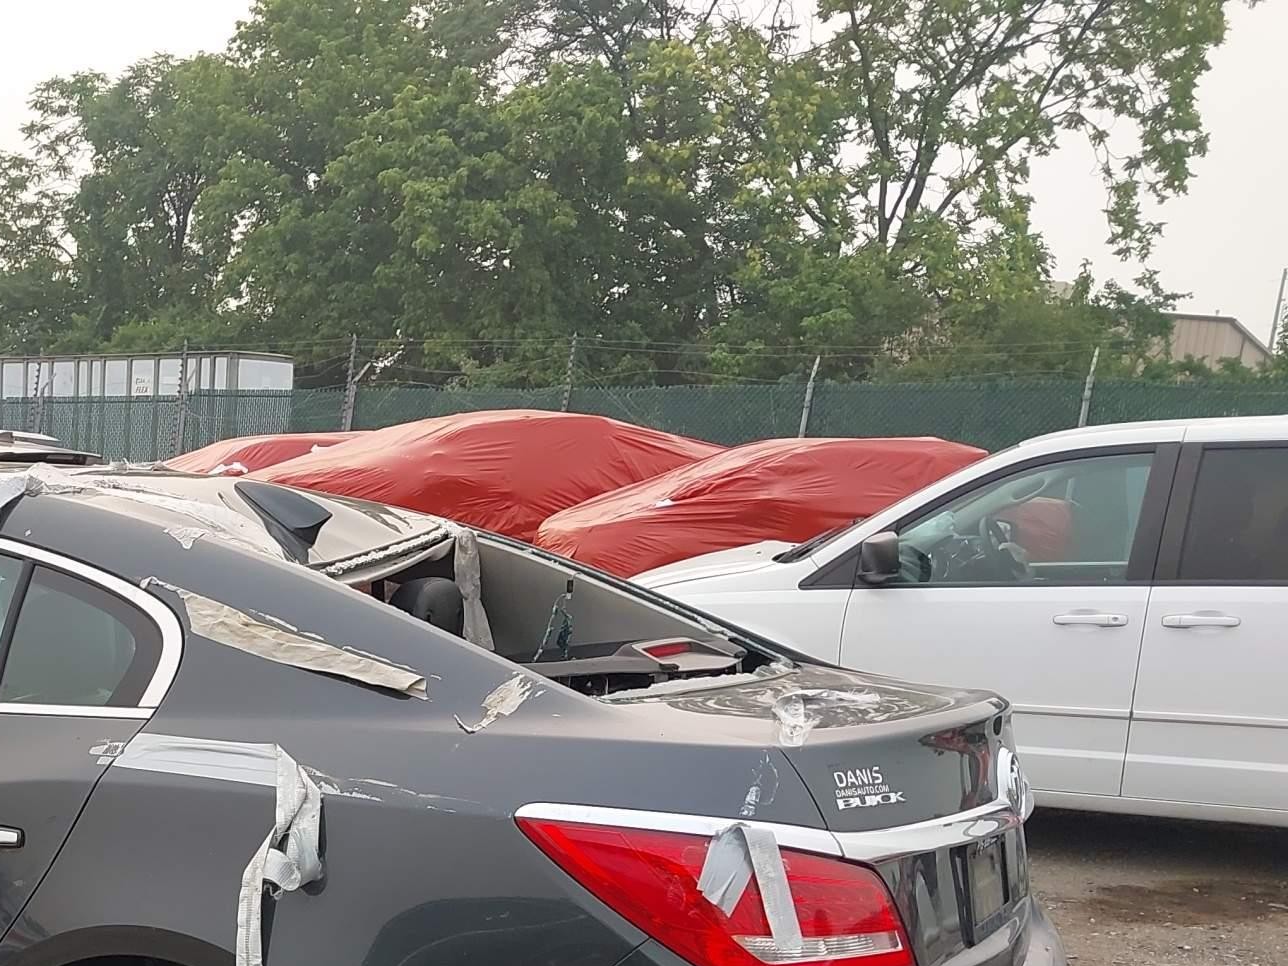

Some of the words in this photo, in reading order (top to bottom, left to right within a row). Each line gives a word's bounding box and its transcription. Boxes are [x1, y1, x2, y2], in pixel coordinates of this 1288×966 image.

[833, 766, 883, 788] DANIS
[835, 784, 890, 798] DANISAUTO.COM
[836, 791, 907, 811] BUICK
